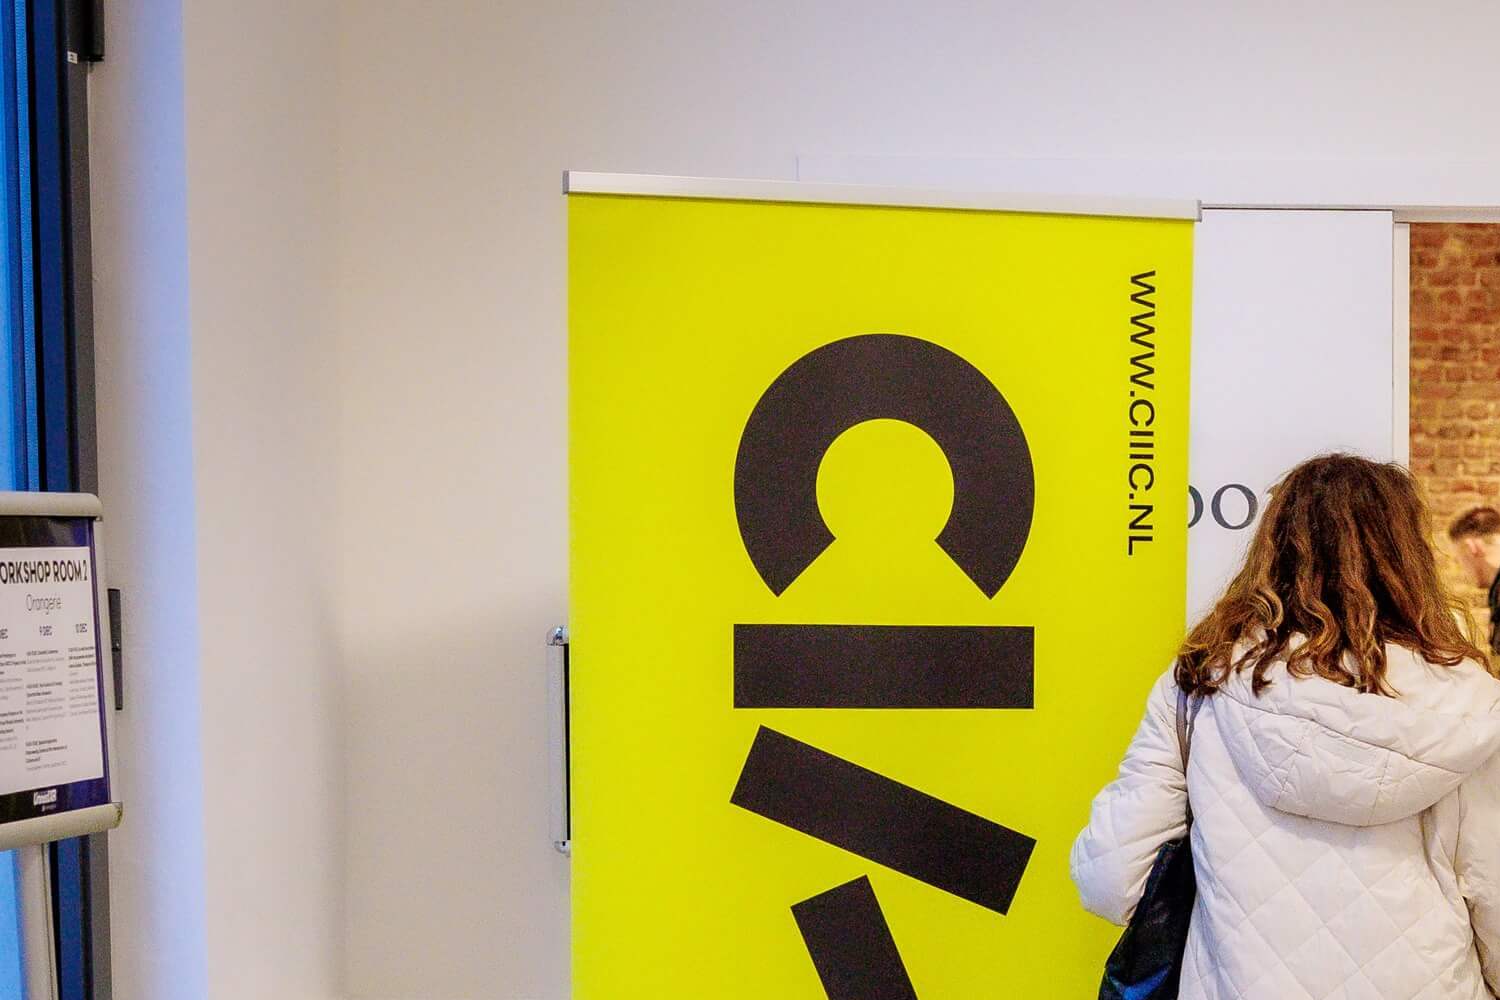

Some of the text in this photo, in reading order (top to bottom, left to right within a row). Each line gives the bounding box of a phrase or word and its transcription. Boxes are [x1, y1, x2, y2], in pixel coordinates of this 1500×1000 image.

[1128, 270, 1156, 556] WWW.CIIIC.NL
[0, 559, 88, 585] ORKSHOP ROOM 2
